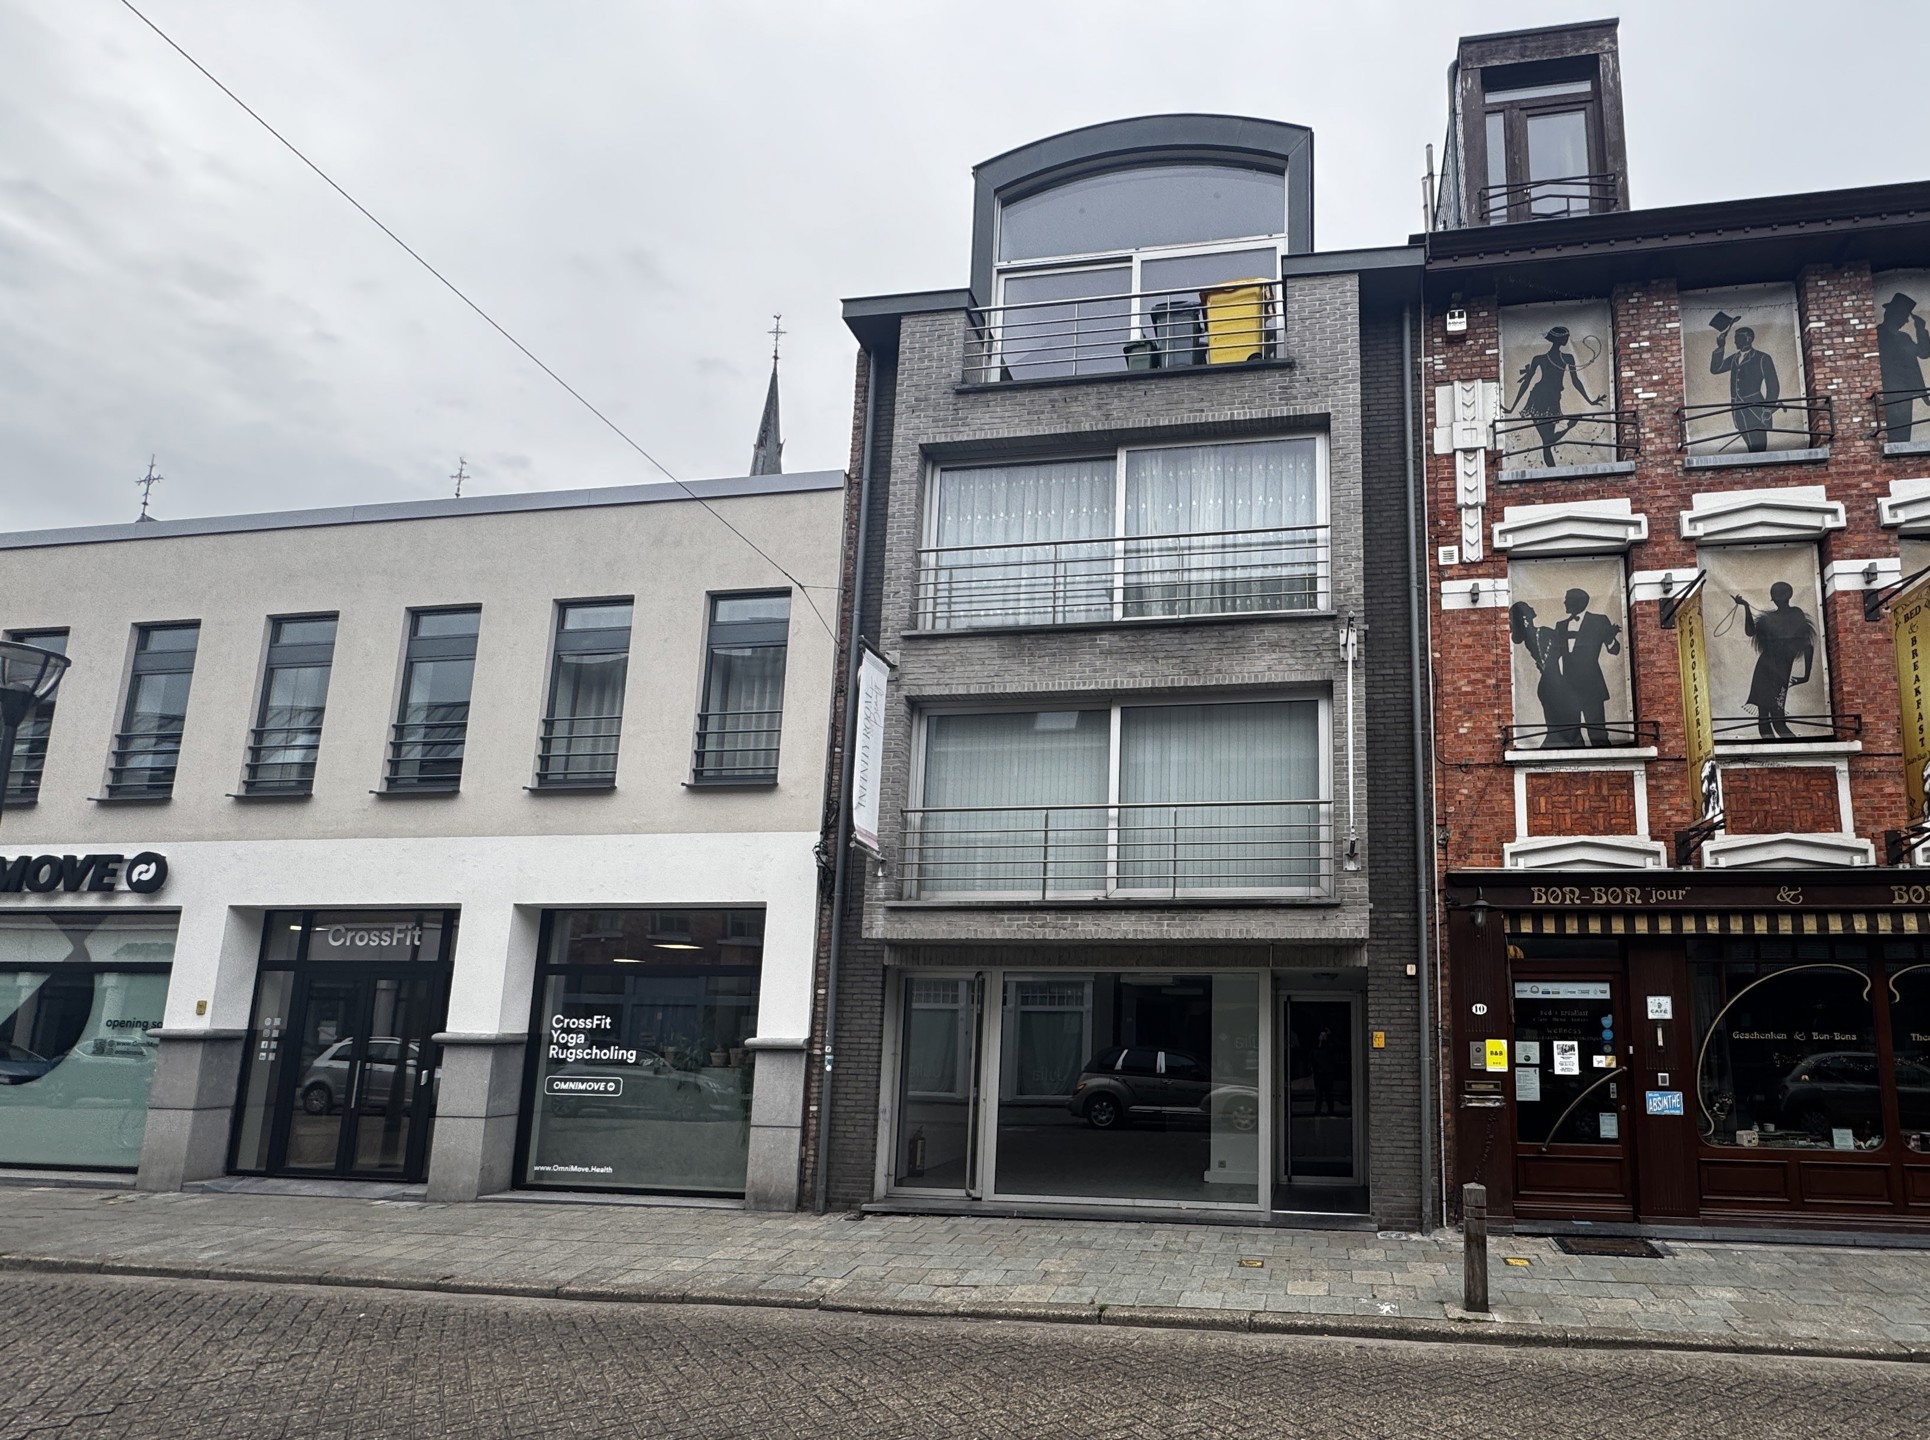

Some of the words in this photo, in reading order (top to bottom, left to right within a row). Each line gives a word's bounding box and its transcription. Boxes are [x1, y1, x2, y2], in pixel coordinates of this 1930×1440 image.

[1903, 604, 1921, 624] BED
[1908, 621, 1919, 634] &
[1688, 615, 1703, 751] CHOCOLATERIE
[1911, 635, 1925, 748] BREAKFAST
[862, 687, 874, 741] ROOM
[857, 744, 871, 808] INFINITY
[0, 854, 125, 893] MOVE
[1531, 887, 1642, 905] BON-BON
[1776, 886, 1803, 905] &
[1890, 885, 1930, 904] BO
[328, 924, 421, 946] CrossFit
[106, 1018, 149, 1031] opening
[552, 1014, 611, 1029] CrossFit
[551, 1029, 585, 1047] Yoga
[1732, 1031, 1787, 1040] Geschenken
[1793, 1032, 1806, 1041] &
[1812, 1032, 1857, 1041] Bon-Bons
[549, 1045, 637, 1063] Rugscholing
[553, 1081, 606, 1091] OMNIMOVE
[1649, 1093, 1680, 1112] ABSINTHE
[534, 1164, 613, 1173] www.OmniMove.Health
